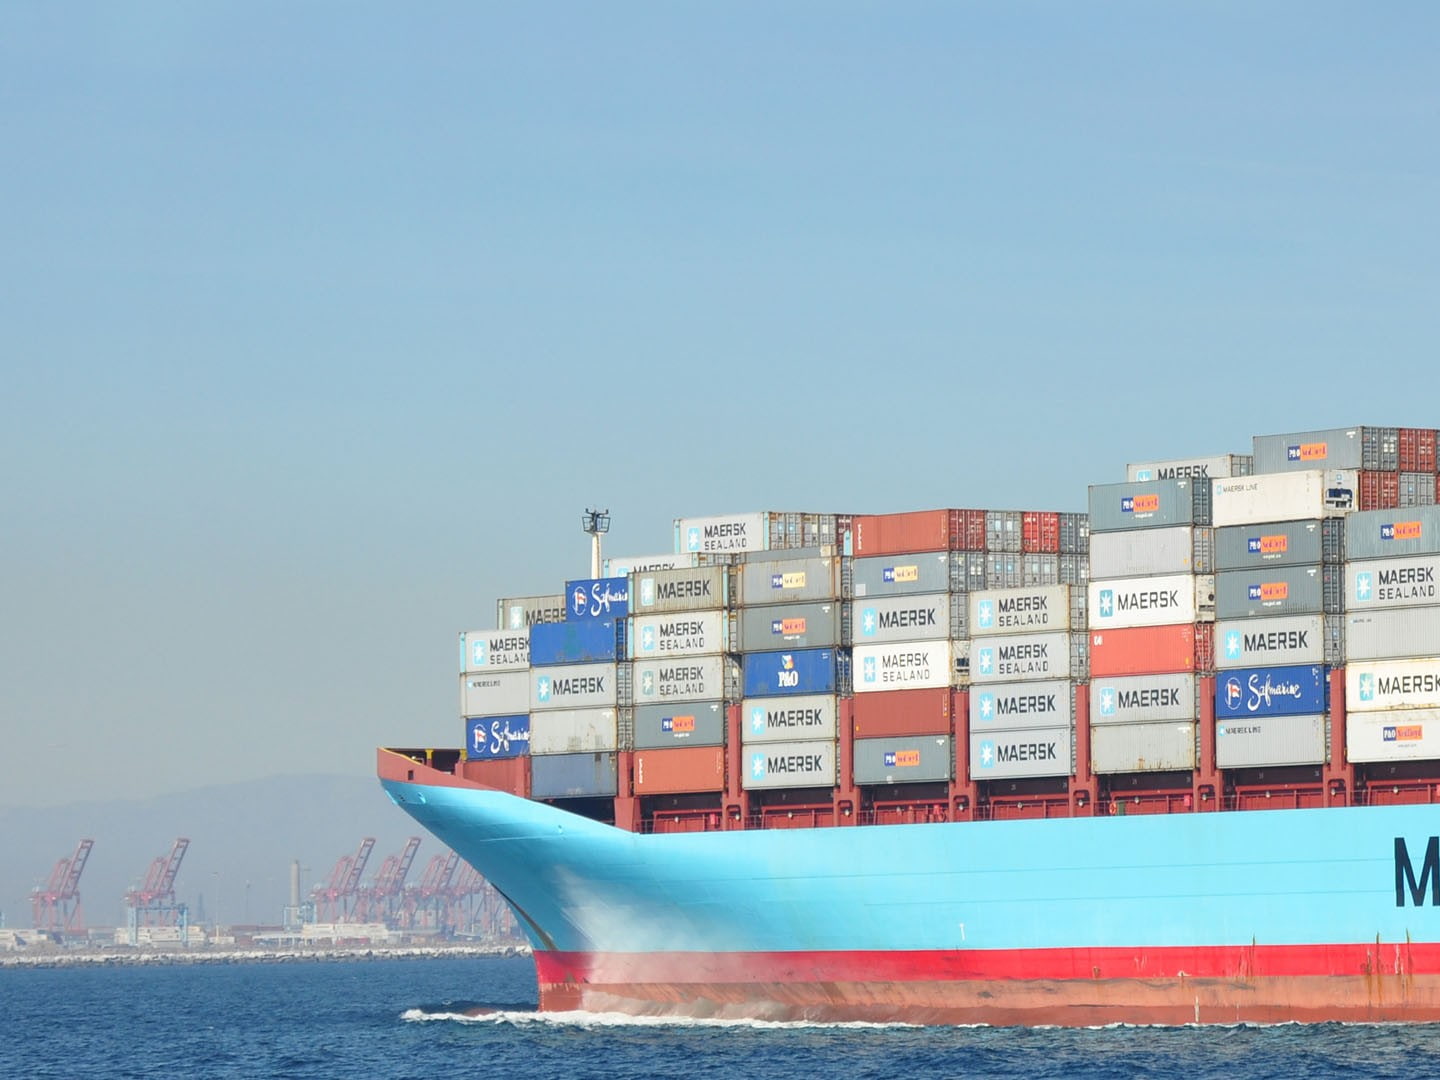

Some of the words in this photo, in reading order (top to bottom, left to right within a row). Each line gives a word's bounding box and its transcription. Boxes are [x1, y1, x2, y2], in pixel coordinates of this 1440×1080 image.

[704, 523, 746, 538] MAERSK
[704, 538, 747, 550] SEALAND
[1379, 568, 1434, 585] MAERSK
[657, 579, 710, 599] MAERSK
[1379, 586, 1434, 600] SEALAND
[999, 597, 1048, 612] MAERSK
[1118, 591, 1178, 611] MAERSK
[879, 608, 935, 628] MAERSK
[999, 614, 1048, 627] SEALAND
[660, 621, 704, 637] MAERSK
[660, 637, 704, 650] SEALAND
[1244, 631, 1308, 652] MAERSK
[999, 644, 1048, 659] MAERSK
[882, 653, 929, 668] MAERSK
[999, 661, 1048, 674] SEALAND
[659, 667, 704, 681] MAERSK
[882, 669, 930, 682] SEALAND
[553, 676, 604, 694] MAERSK
[660, 682, 704, 695] SEALAND
[1248, 674, 1301, 711] Safmarine
[998, 695, 1056, 713] MAERSK
[1119, 688, 1179, 707] MAERSK
[767, 709, 822, 727] MAERSK
[998, 742, 1056, 762] MAERSK
[767, 754, 822, 773] MAERSK
